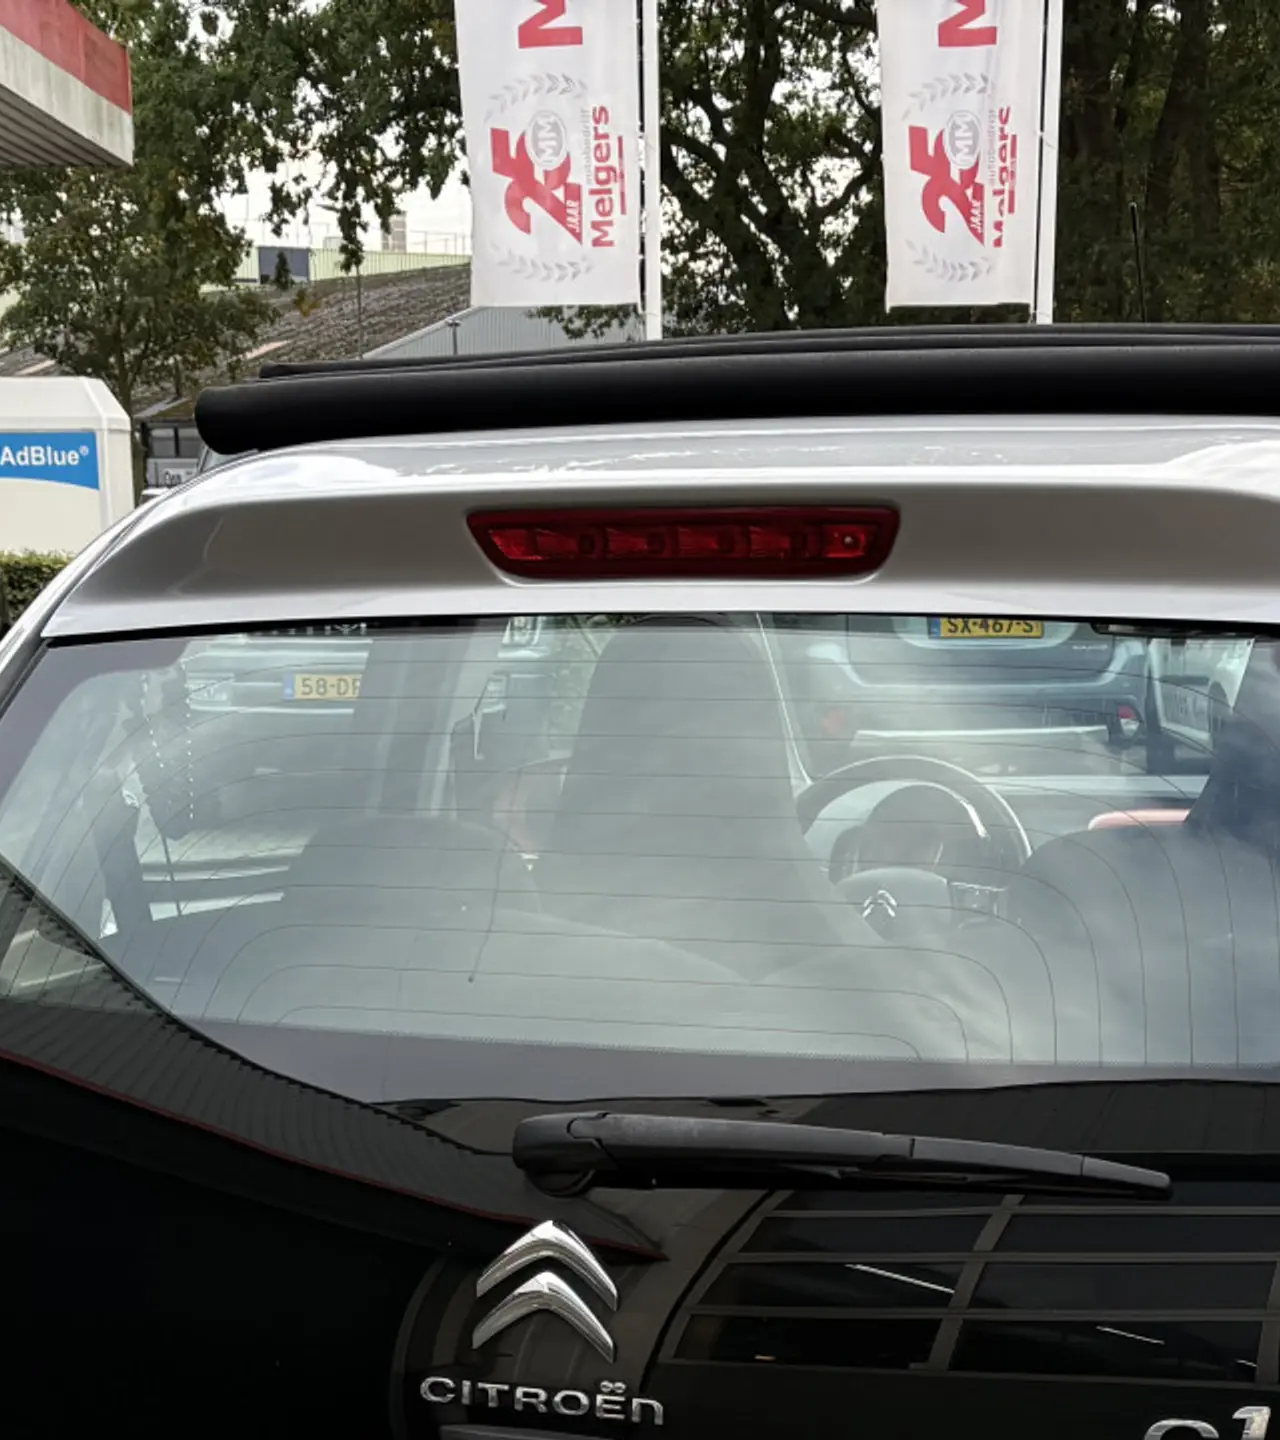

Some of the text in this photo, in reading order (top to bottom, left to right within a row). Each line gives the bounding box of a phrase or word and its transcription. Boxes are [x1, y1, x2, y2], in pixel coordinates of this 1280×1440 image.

[538, 116, 559, 161] MM
[953, 116, 974, 160] MM
[588, 104, 618, 248] Melgers
